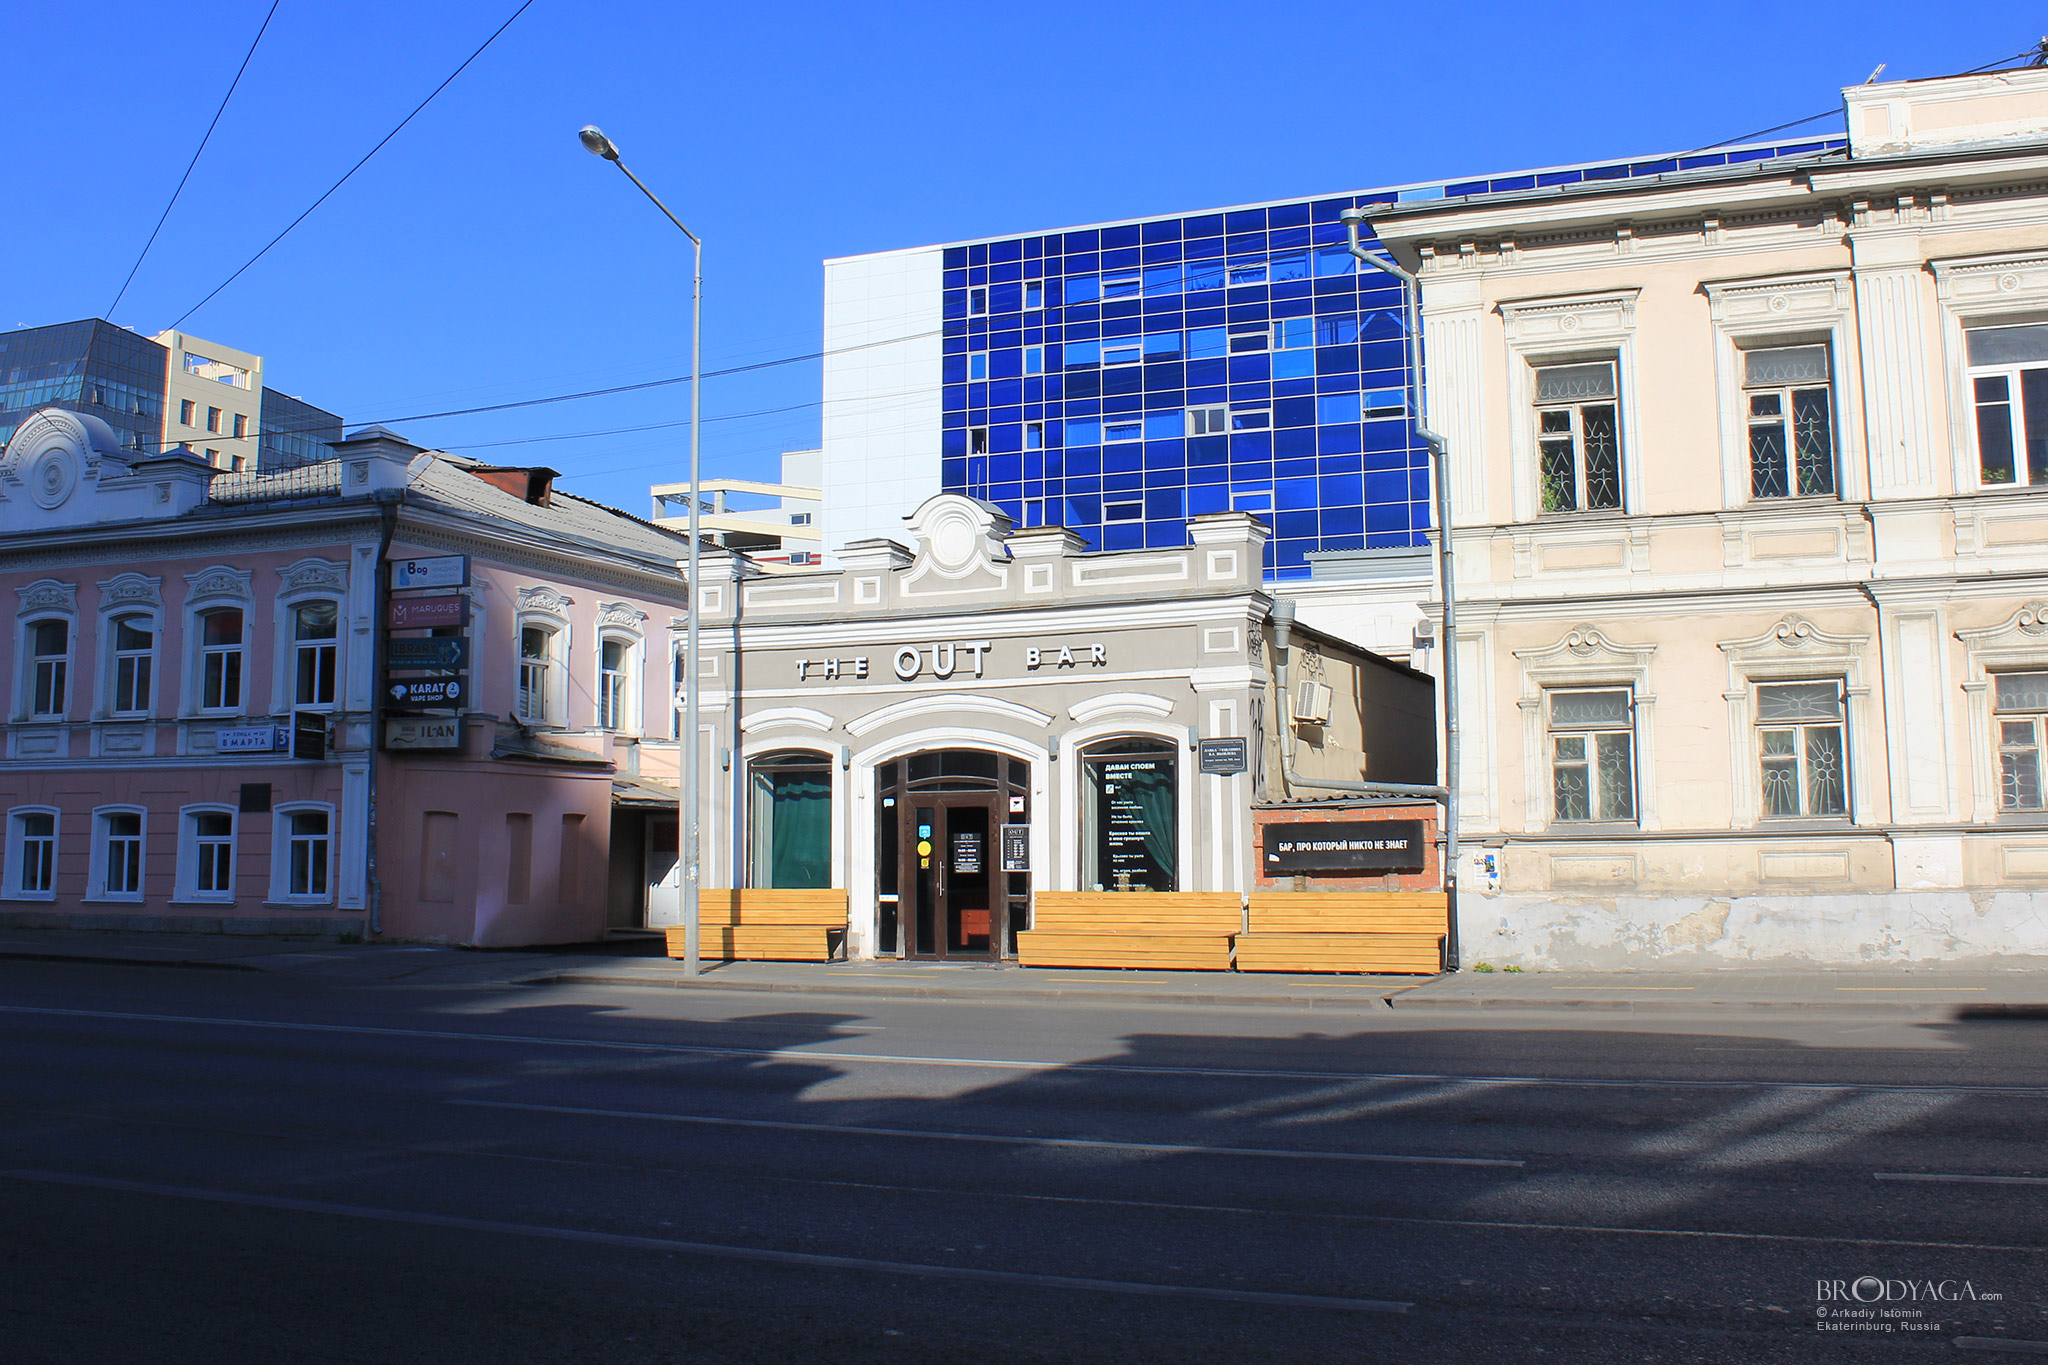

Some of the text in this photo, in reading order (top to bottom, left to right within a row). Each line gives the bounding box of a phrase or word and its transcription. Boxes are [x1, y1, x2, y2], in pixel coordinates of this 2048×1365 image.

[796, 641, 1106, 681] THE OUT BAR
[410, 682, 446, 694] KARAT
[222, 738, 267, 747] 8 МАРТА
[1130, 762, 1156, 770] СПОЕМ
[1105, 772, 1133, 780] ВМЕСТЕ
[1278, 840, 1408, 852] БАР, ПРО КОТОРЫЙ НИКТО НЕ ЗНАЕТ
